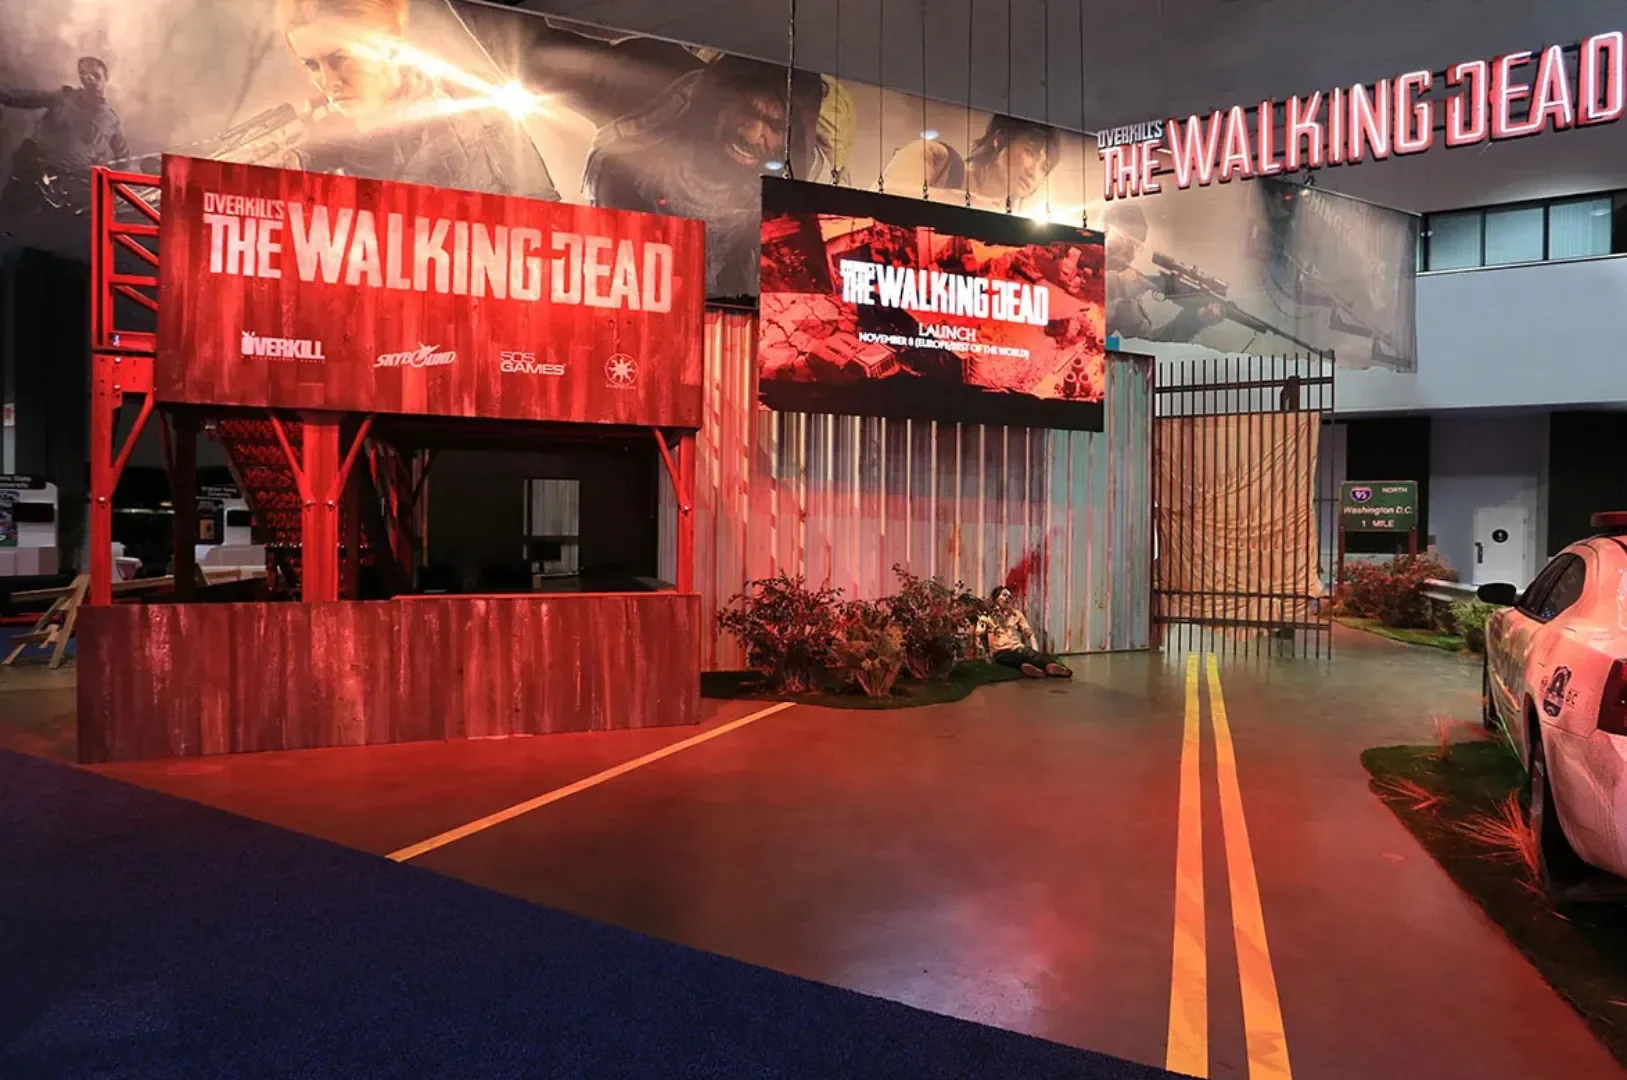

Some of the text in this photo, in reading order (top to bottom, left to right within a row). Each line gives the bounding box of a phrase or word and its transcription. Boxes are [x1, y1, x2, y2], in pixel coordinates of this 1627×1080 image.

[1098, 30, 1626, 201] THE WALKING DEAD
[1097, 119, 1164, 149] OVERKILL'S
[203, 192, 284, 220] OVERKILL'S
[203, 201, 673, 314] THE WALKING DEAD
[840, 264, 1050, 327] THE WALKING DEAD
[858, 331, 907, 346] NOVEMBER
[918, 322, 977, 342] LAUNCH
[241, 331, 326, 360] OVERKILL
[373, 342, 456, 368] SKYBOUND
[500, 362, 566, 376] GAMES
[1355, 491, 1367, 500] 95
[1343, 506, 1394, 515] Washington
[1361, 520, 1395, 528] 1 MILE
